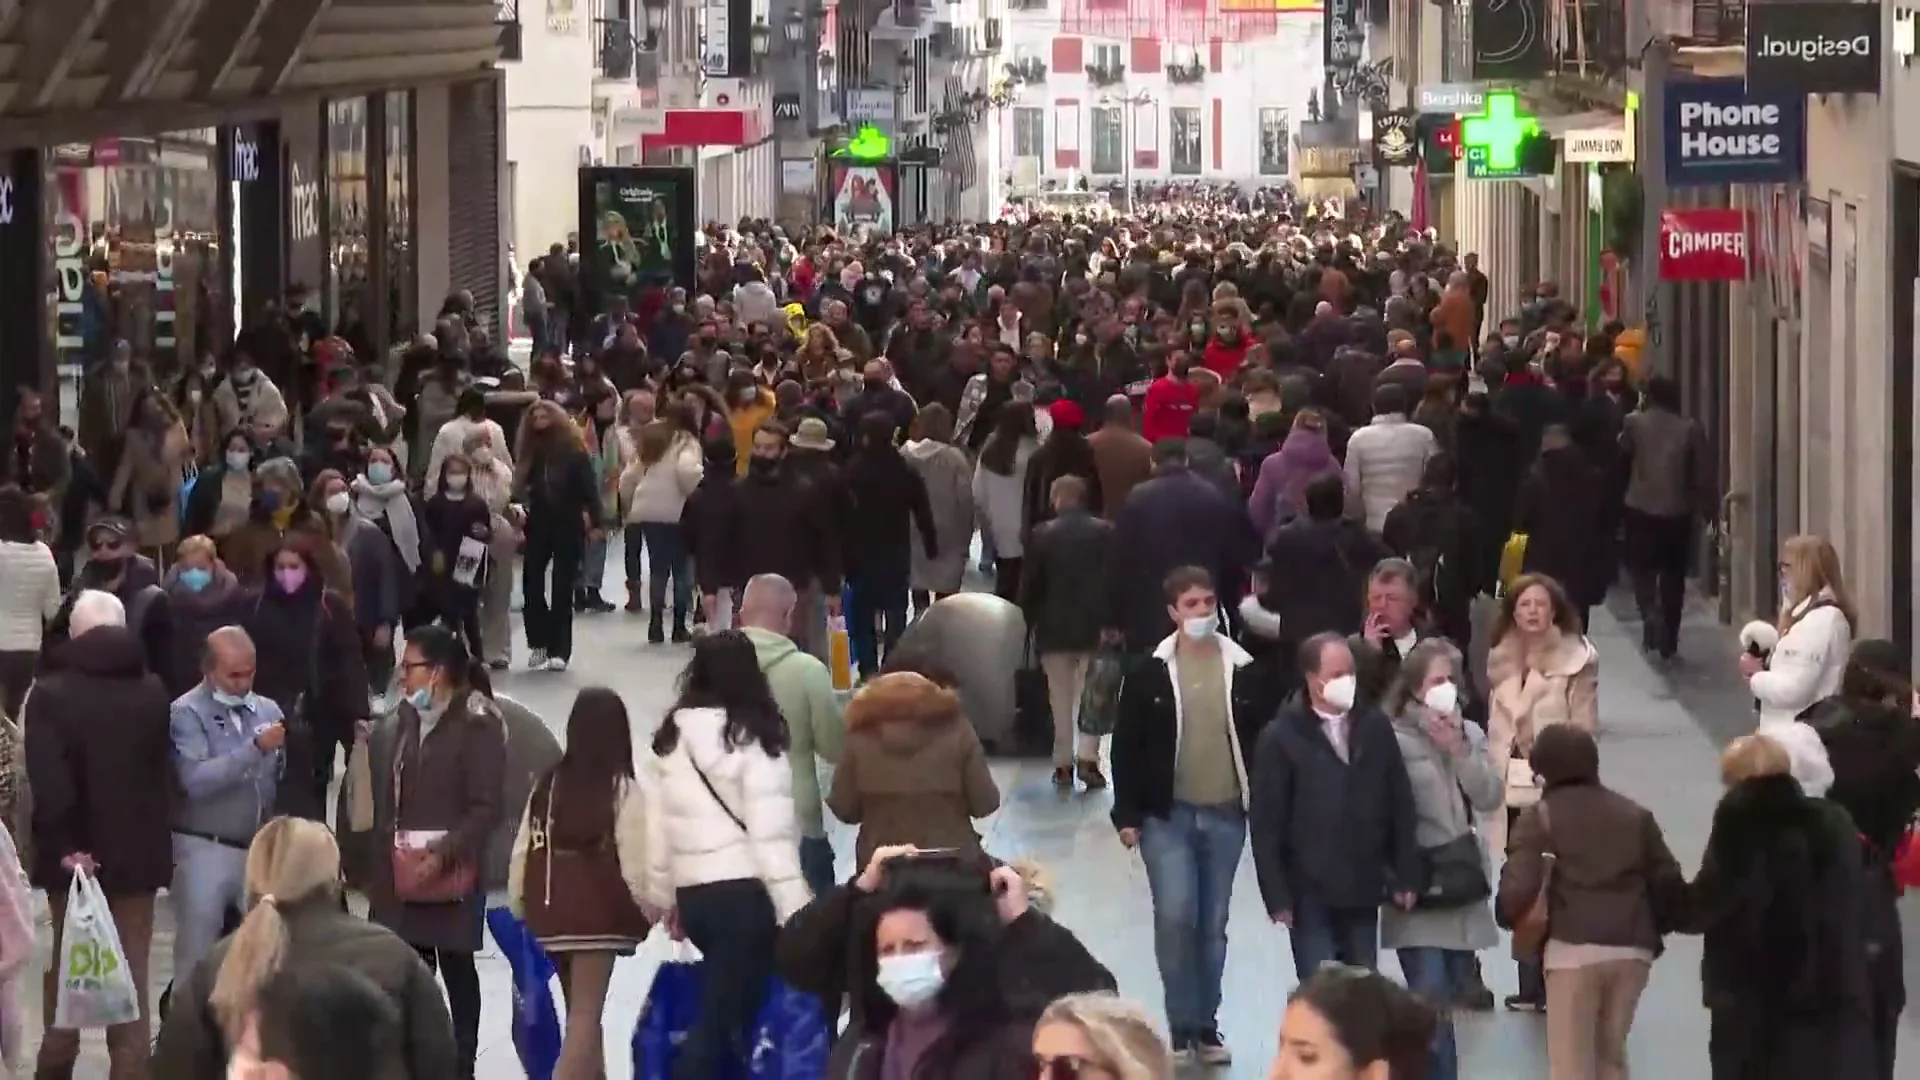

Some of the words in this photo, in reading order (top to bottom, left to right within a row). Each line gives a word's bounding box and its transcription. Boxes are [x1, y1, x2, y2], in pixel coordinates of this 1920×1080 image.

[1680, 102, 1779, 127] Phone
[235, 126, 259, 181] fnac
[1681, 132, 1780, 157] House
[292, 161, 319, 240] fnac
[1669, 232, 1744, 259] CAMPER
